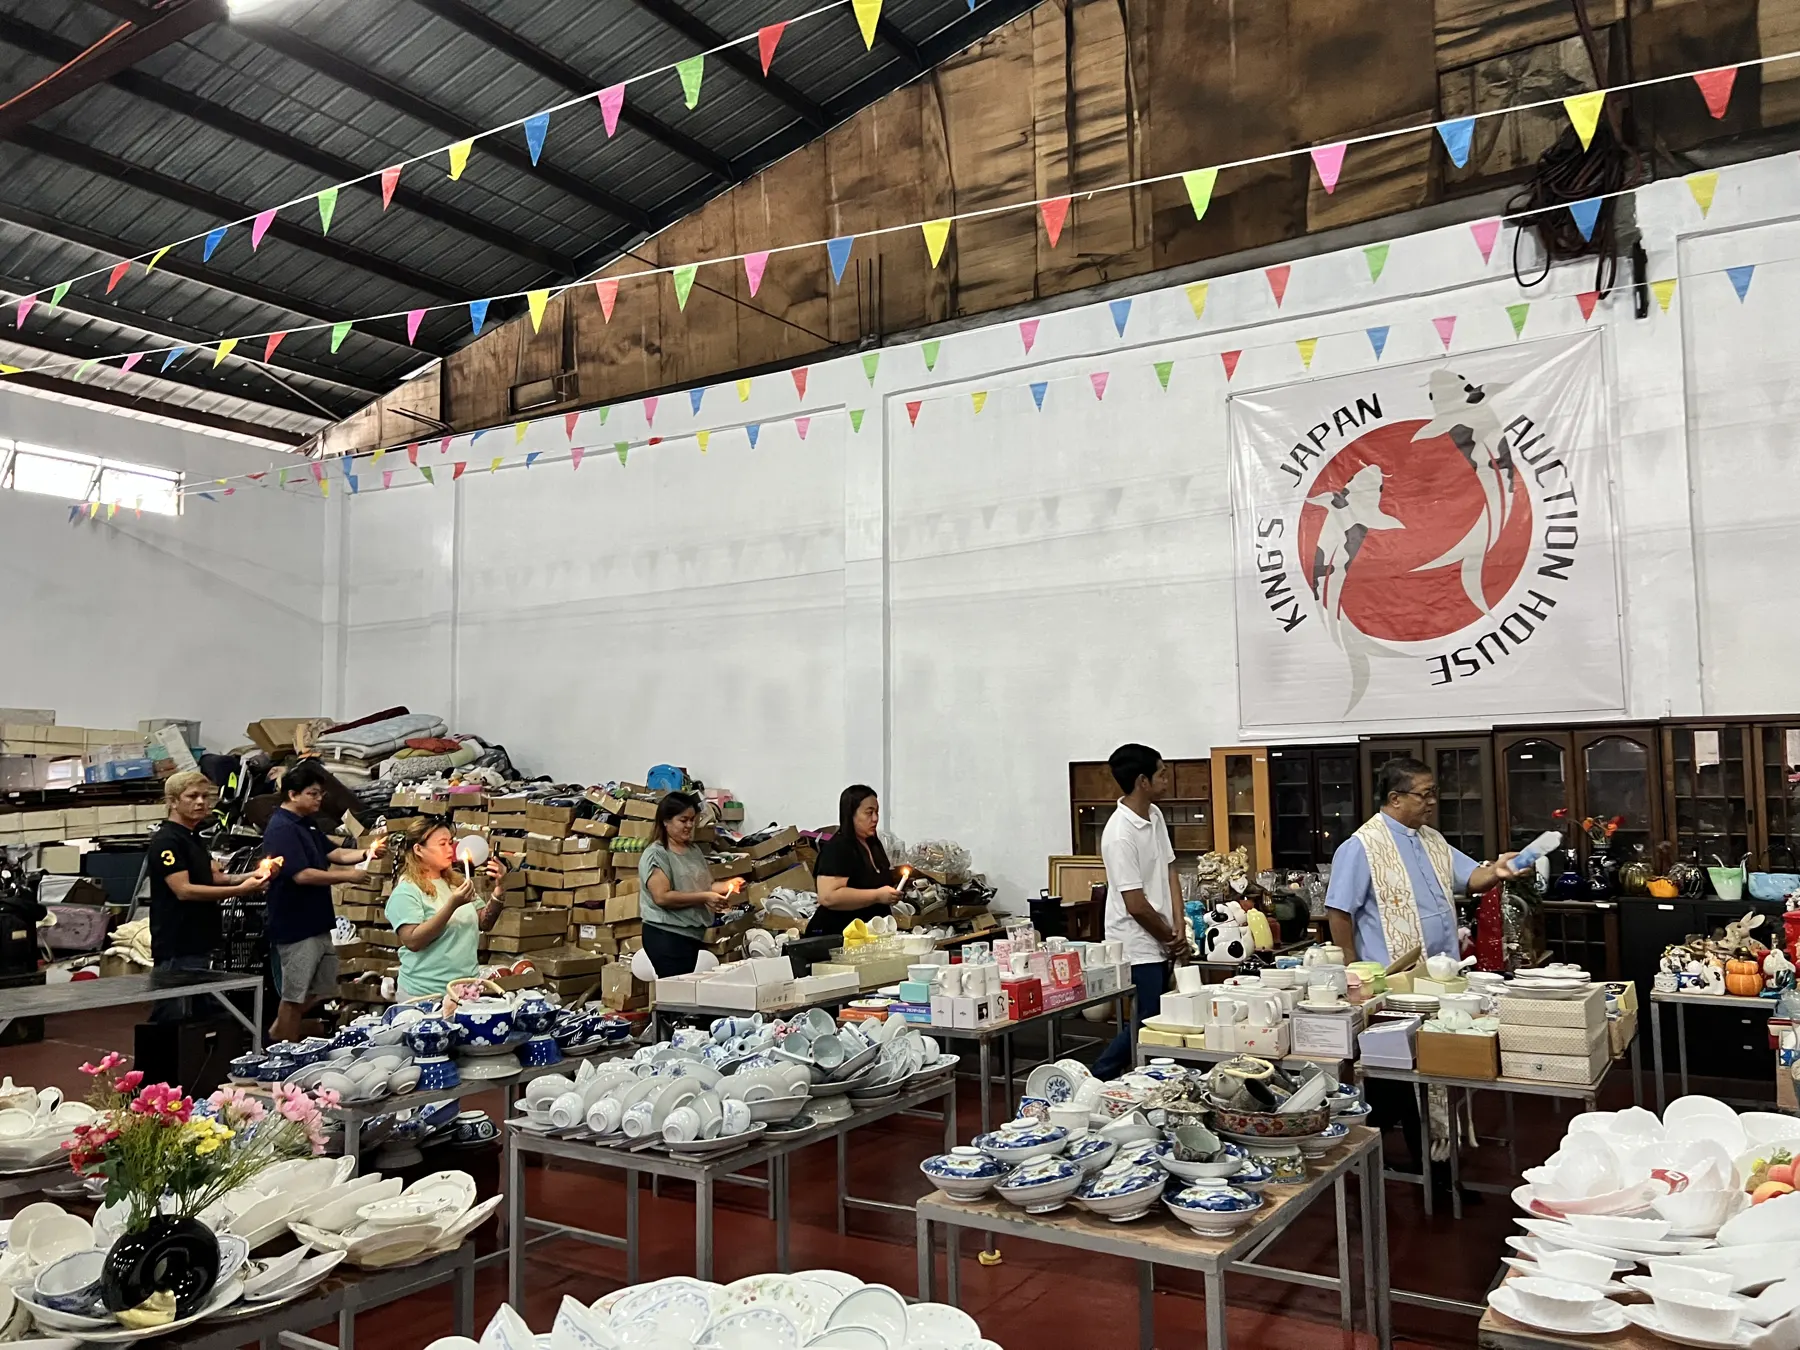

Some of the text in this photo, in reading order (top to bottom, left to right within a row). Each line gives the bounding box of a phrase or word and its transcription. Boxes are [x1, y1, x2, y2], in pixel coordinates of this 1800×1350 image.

[1256, 393, 1579, 686] KING'S JAPAN AUCTION HOUSE
[161, 850, 175, 865] 3
